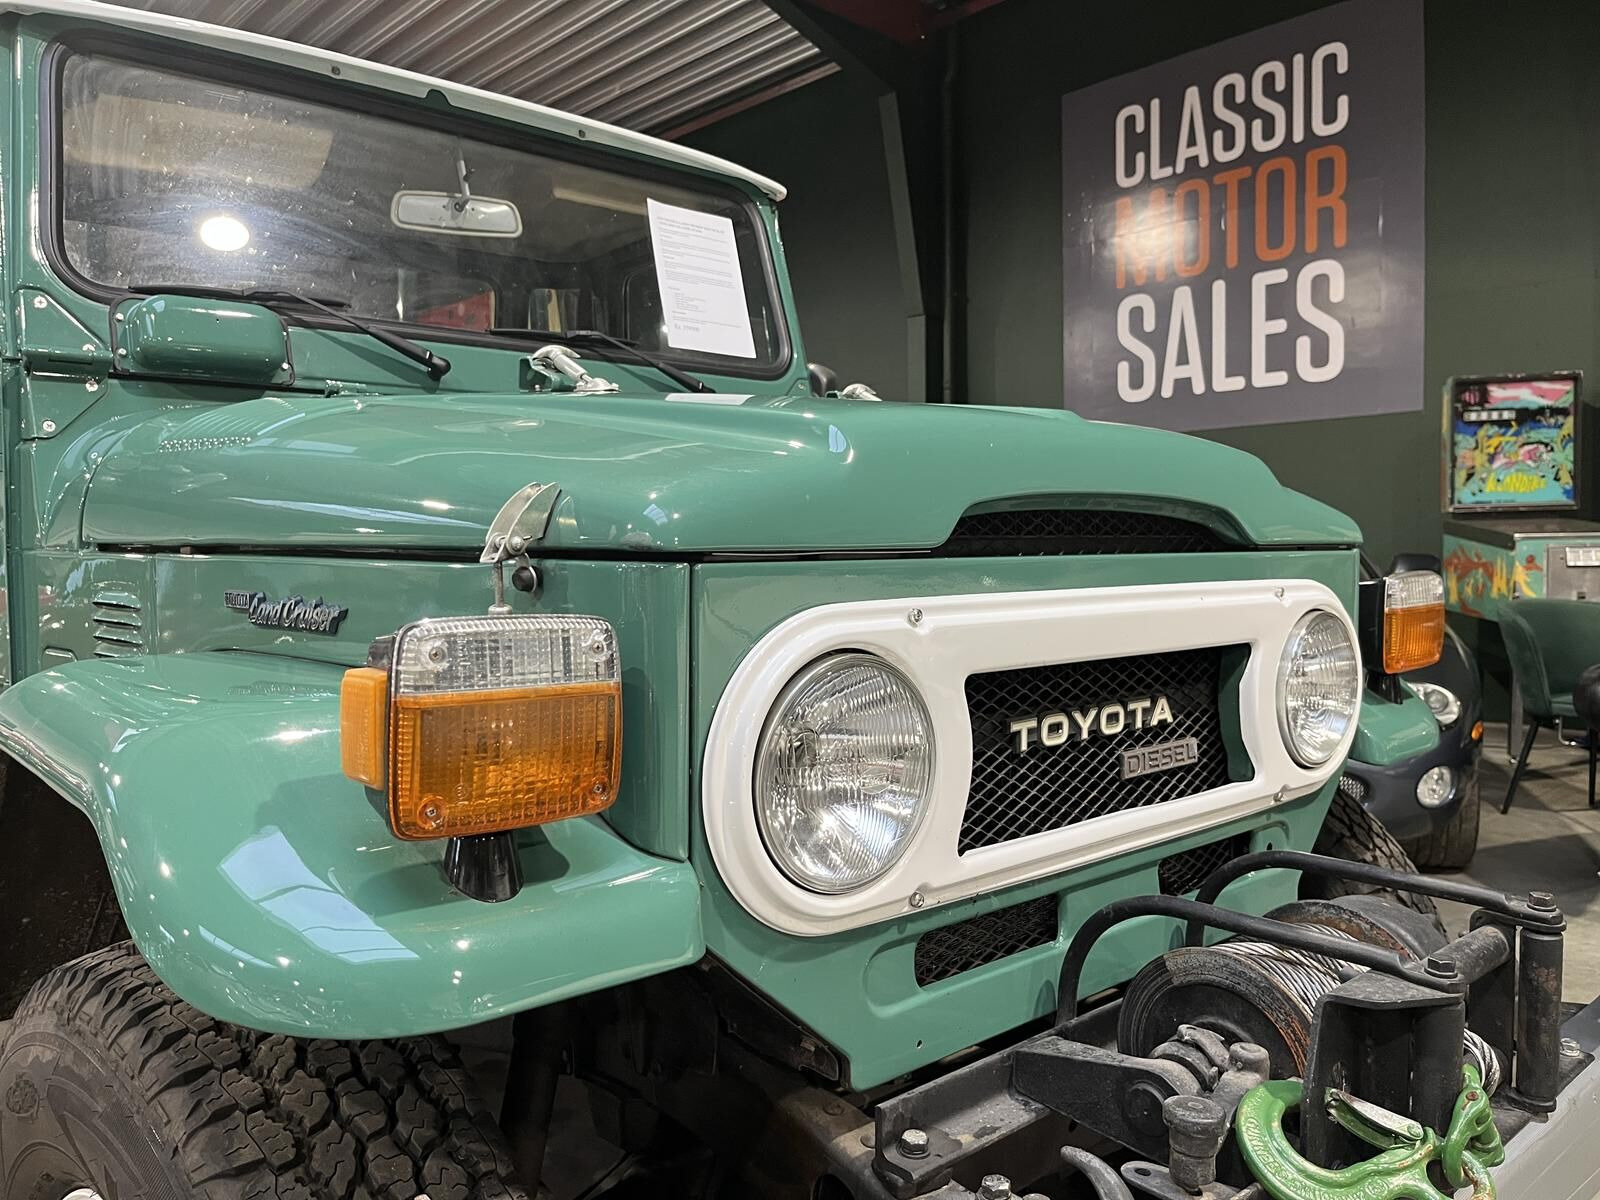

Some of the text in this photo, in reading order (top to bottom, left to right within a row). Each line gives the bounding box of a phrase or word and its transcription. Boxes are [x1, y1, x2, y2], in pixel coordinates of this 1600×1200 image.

[1114, 40, 1350, 189] CLASSIC
[1114, 144, 1348, 290] MOTOR
[1116, 258, 1346, 404] SALES
[249, 595, 341, 632] Land Cruiser
[1010, 695, 1174, 753] TOYOTA
[1125, 741, 1197, 775] DIESEL
